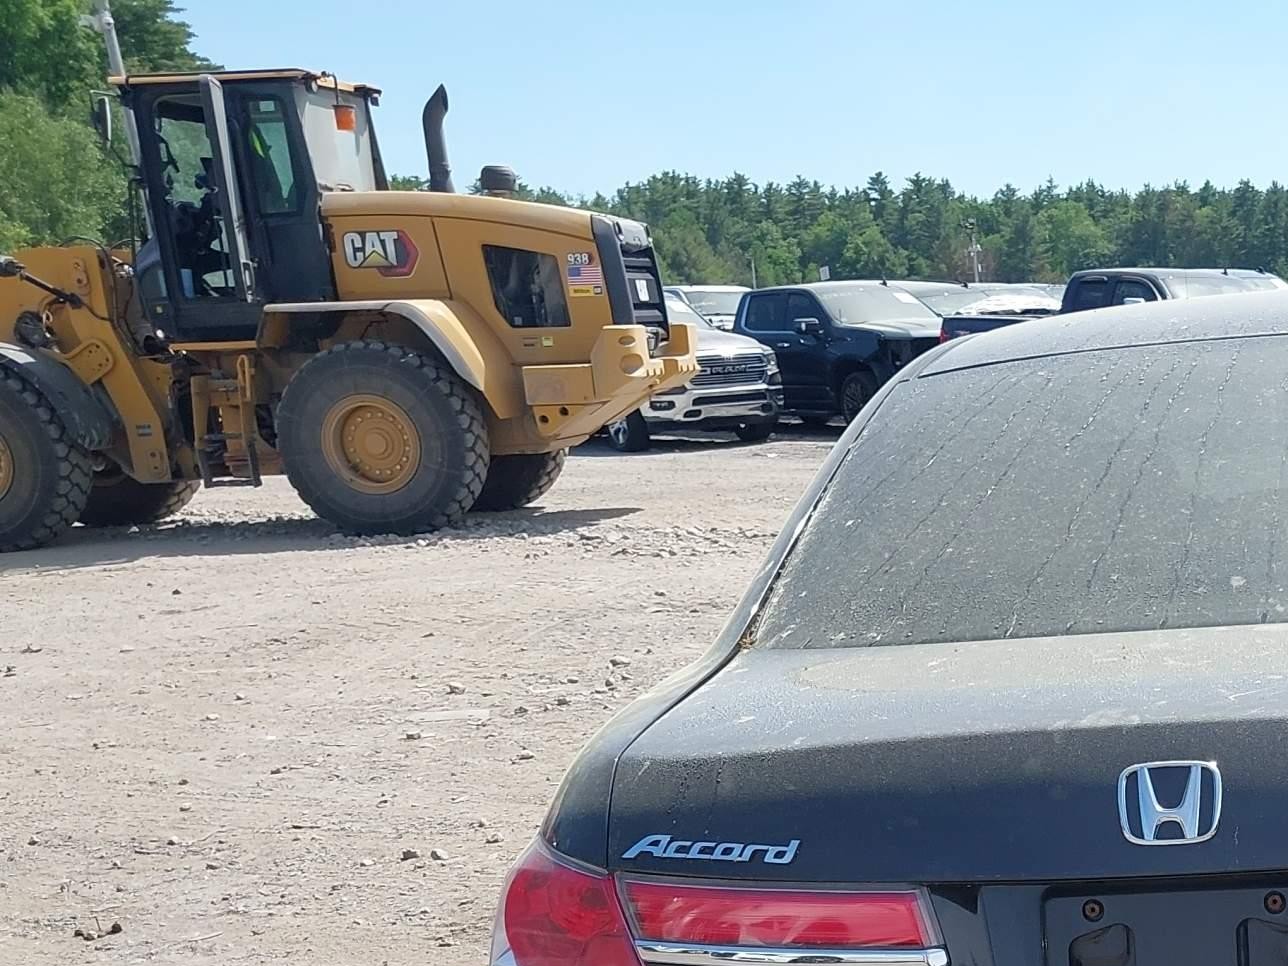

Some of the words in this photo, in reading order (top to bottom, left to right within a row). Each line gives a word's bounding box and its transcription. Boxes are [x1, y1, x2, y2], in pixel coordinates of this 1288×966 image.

[343, 231, 399, 268] CAT
[567, 253, 590, 266] 938
[621, 834, 801, 864] Accord
